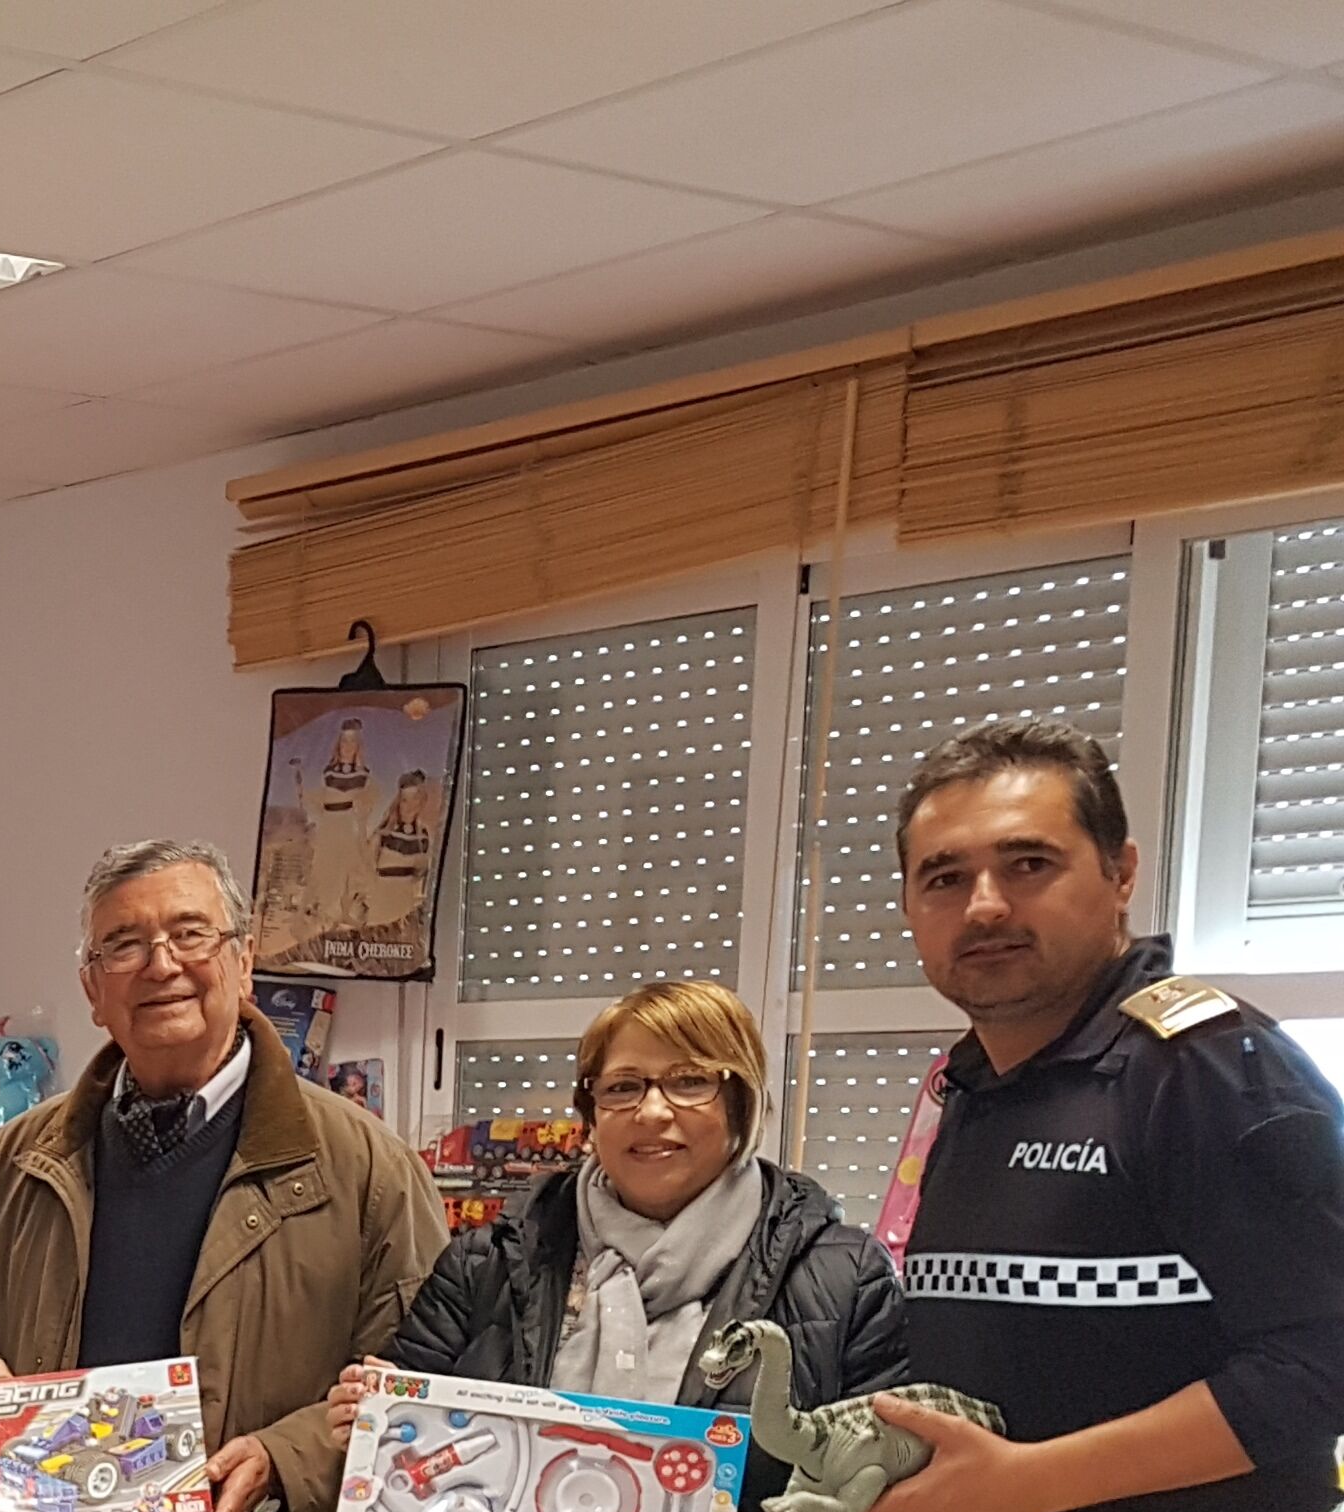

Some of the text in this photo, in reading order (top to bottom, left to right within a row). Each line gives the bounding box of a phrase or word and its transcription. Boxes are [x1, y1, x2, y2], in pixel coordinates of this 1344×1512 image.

[324, 940, 414, 960] INDIA CHEROKEE
[1009, 1139, 1108, 1175] POLICÍA
